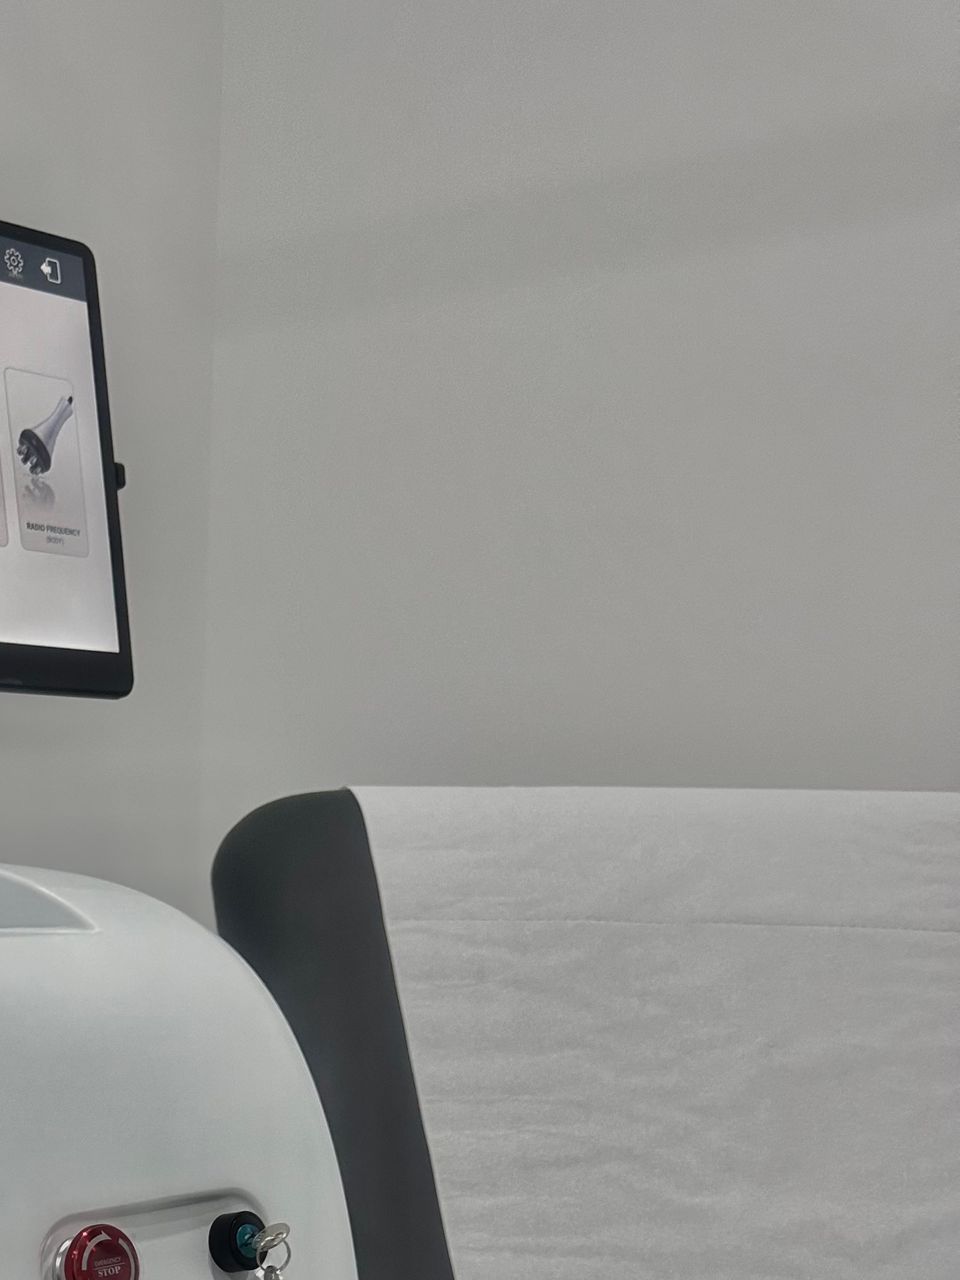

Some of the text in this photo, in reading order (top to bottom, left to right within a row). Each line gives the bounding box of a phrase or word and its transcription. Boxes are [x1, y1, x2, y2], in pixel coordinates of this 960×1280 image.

[26, 521, 81, 537] RADIO FREQUENCY
[97, 1265, 121, 1278] STOP
